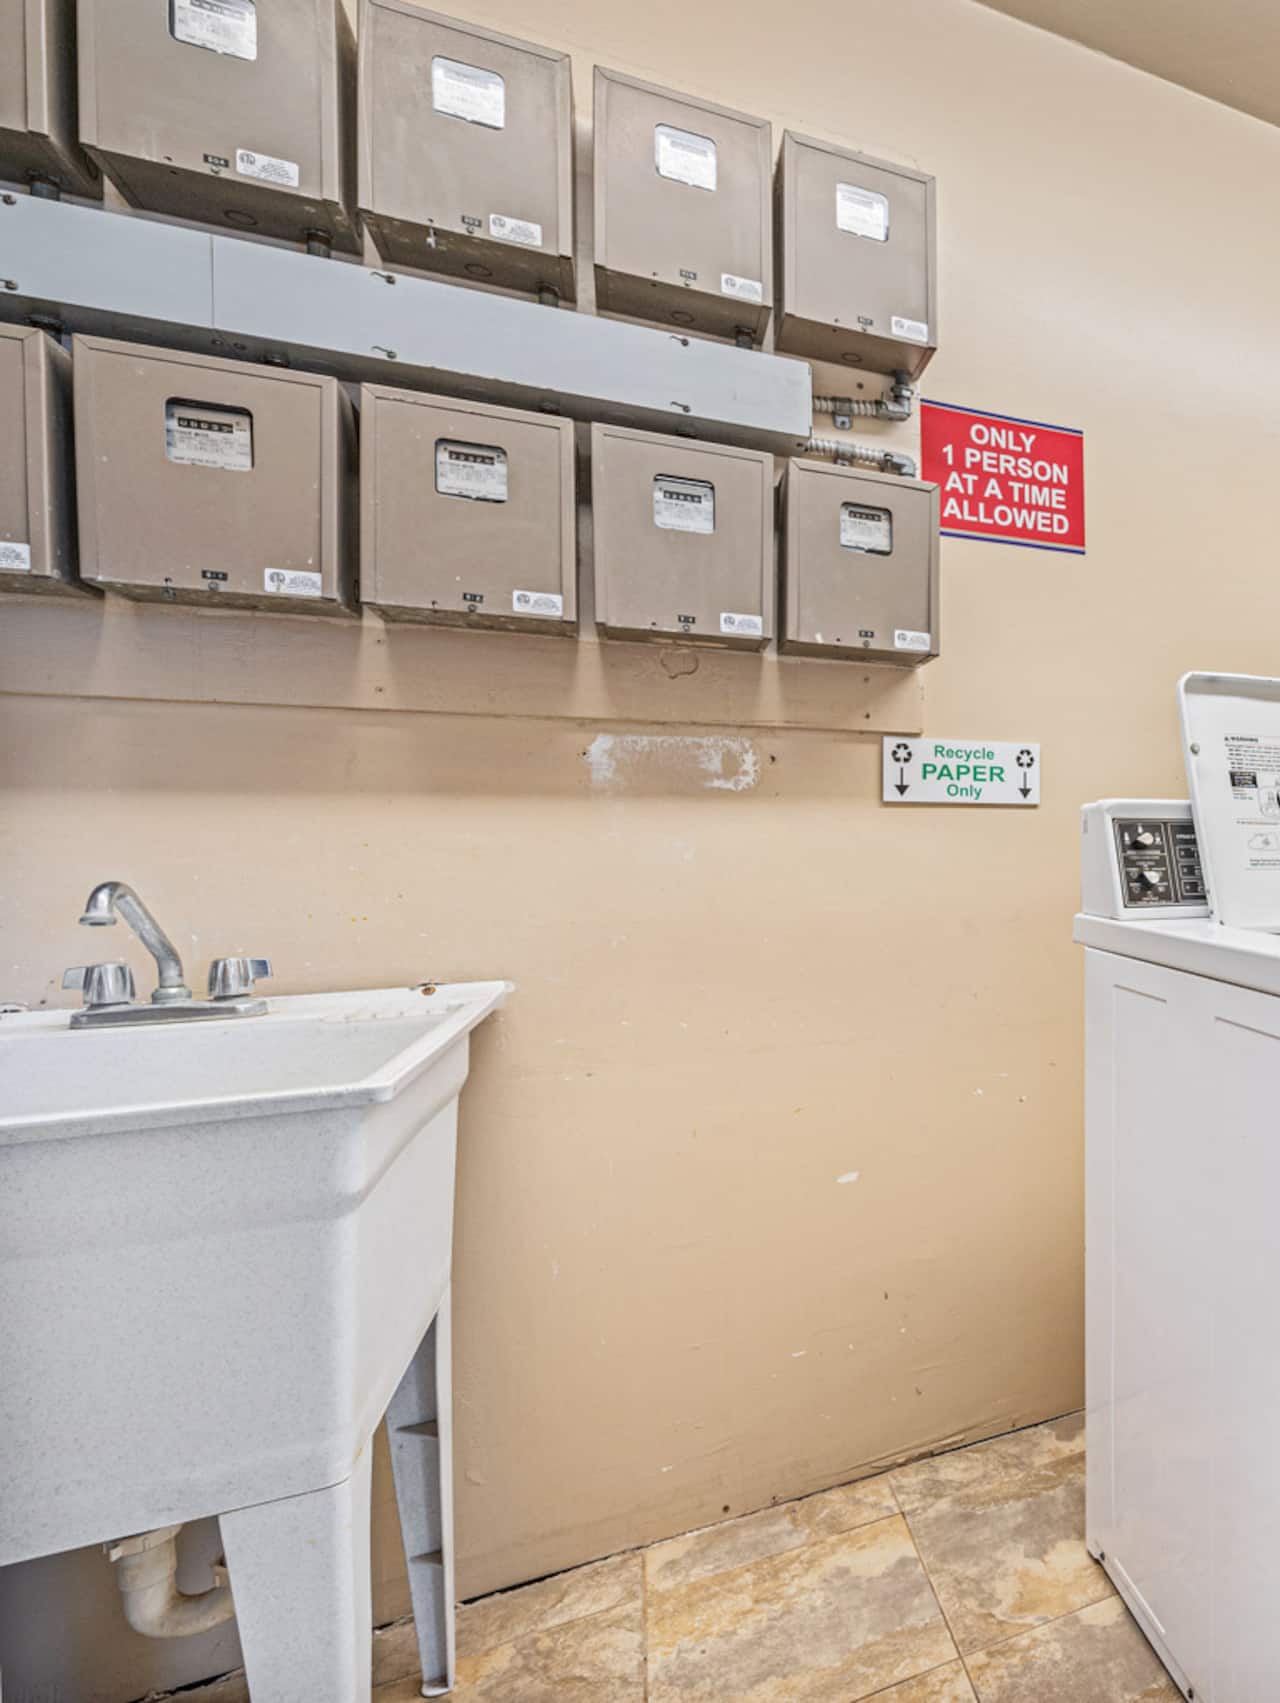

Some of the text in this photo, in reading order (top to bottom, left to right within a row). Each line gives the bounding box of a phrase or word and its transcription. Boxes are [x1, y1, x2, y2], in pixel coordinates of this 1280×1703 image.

[970, 423, 1036, 453] ONLY
[942, 444, 1069, 485] 1 PERSON
[945, 471, 1067, 510] AT A TIME
[943, 497, 1070, 534] ALLOWED
[934, 744, 995, 762] Recycle
[921, 763, 1005, 782] PAPER
[946, 784, 983, 800] Only
